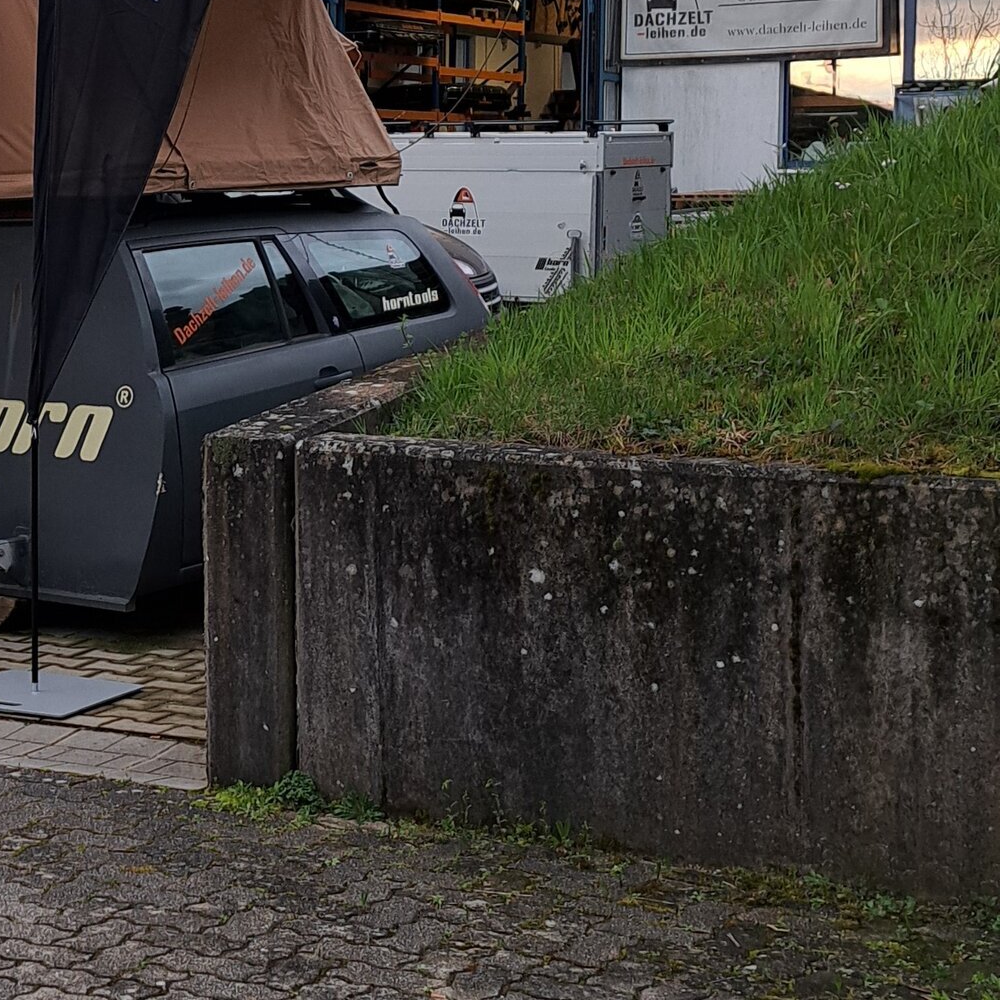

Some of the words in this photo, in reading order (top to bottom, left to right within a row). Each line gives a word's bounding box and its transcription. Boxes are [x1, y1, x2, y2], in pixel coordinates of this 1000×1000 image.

[634, 10, 713, 28] DACHZELT
[727, 17, 868, 37] www.dachzelt-leihen.de
[442, 218, 486, 228] DACHZELT
[382, 288, 439, 312] horntools
